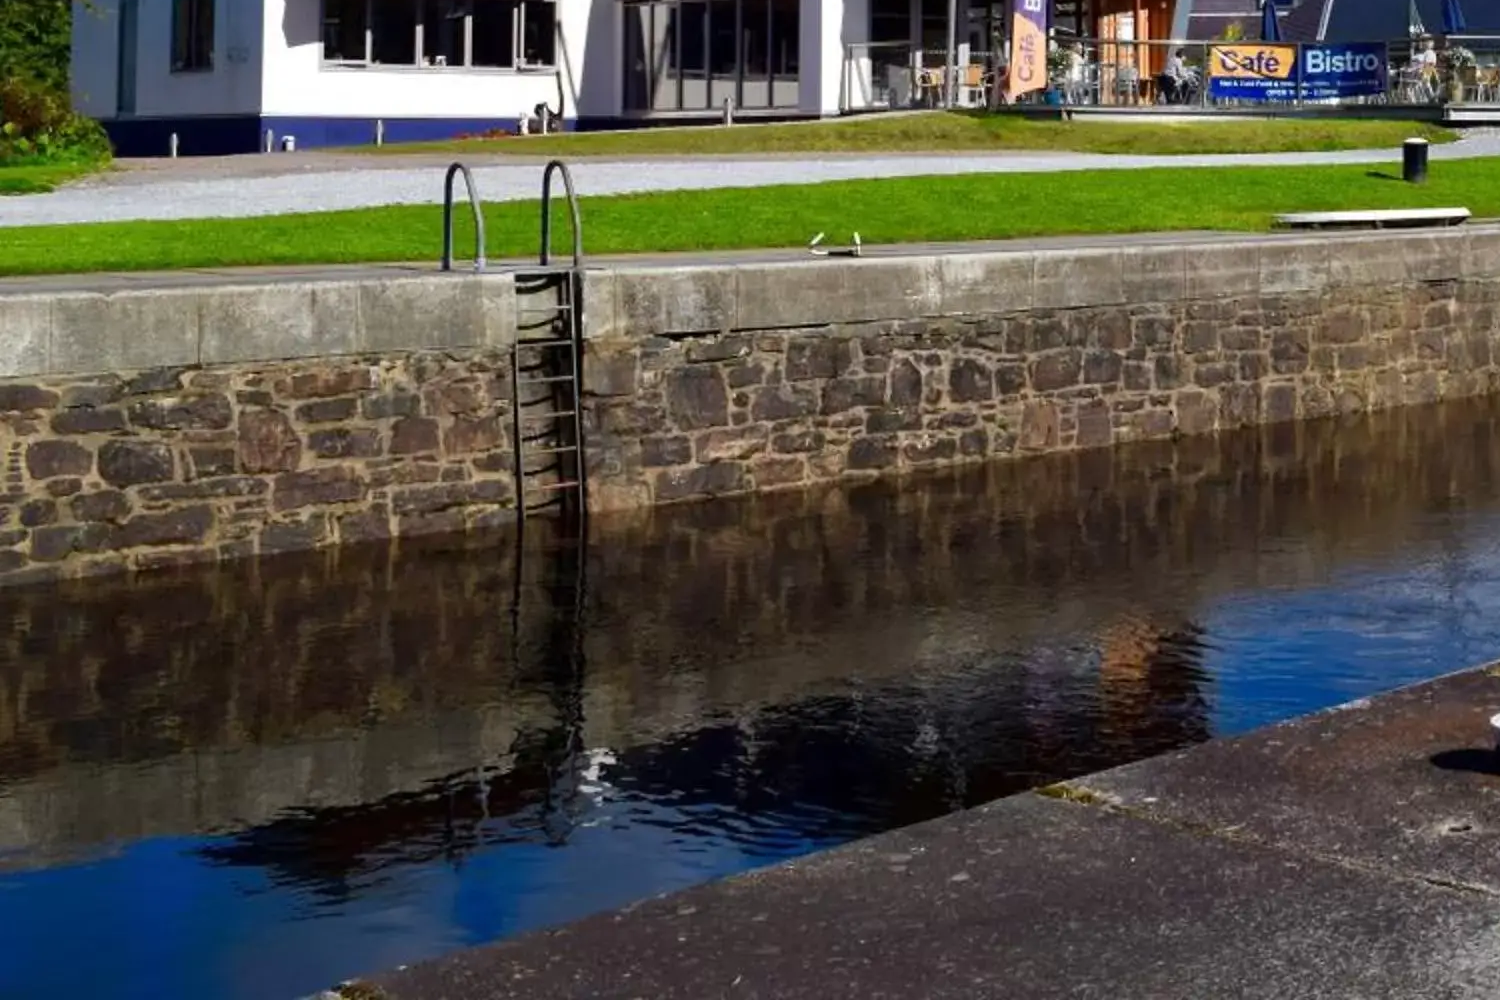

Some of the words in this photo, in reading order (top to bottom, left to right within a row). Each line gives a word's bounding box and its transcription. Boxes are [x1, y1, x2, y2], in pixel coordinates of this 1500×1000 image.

[1017, 33, 1035, 81] Café
[1219, 49, 1281, 73] Café
[1305, 49, 1379, 74] Bistro
